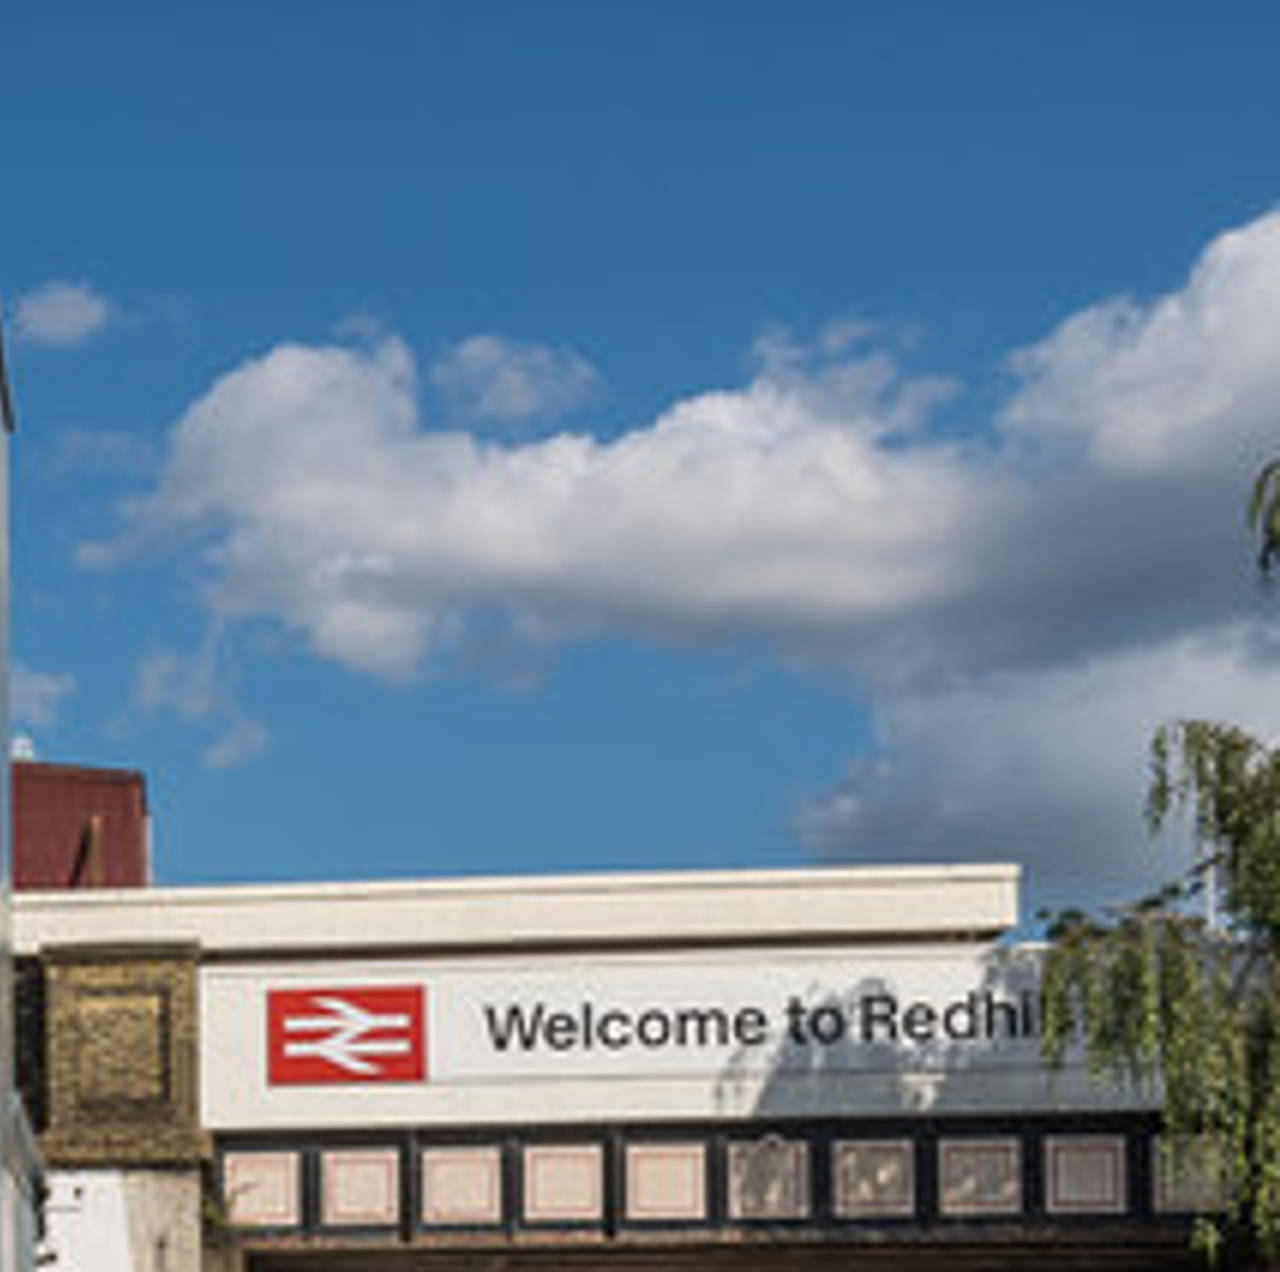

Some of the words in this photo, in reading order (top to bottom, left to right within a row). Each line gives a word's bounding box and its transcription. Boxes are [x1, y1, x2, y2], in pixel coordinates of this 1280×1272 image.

[484, 1002, 768, 1051] Welcome
[786, 995, 848, 1046] to
[859, 990, 1050, 1043] Redhi
